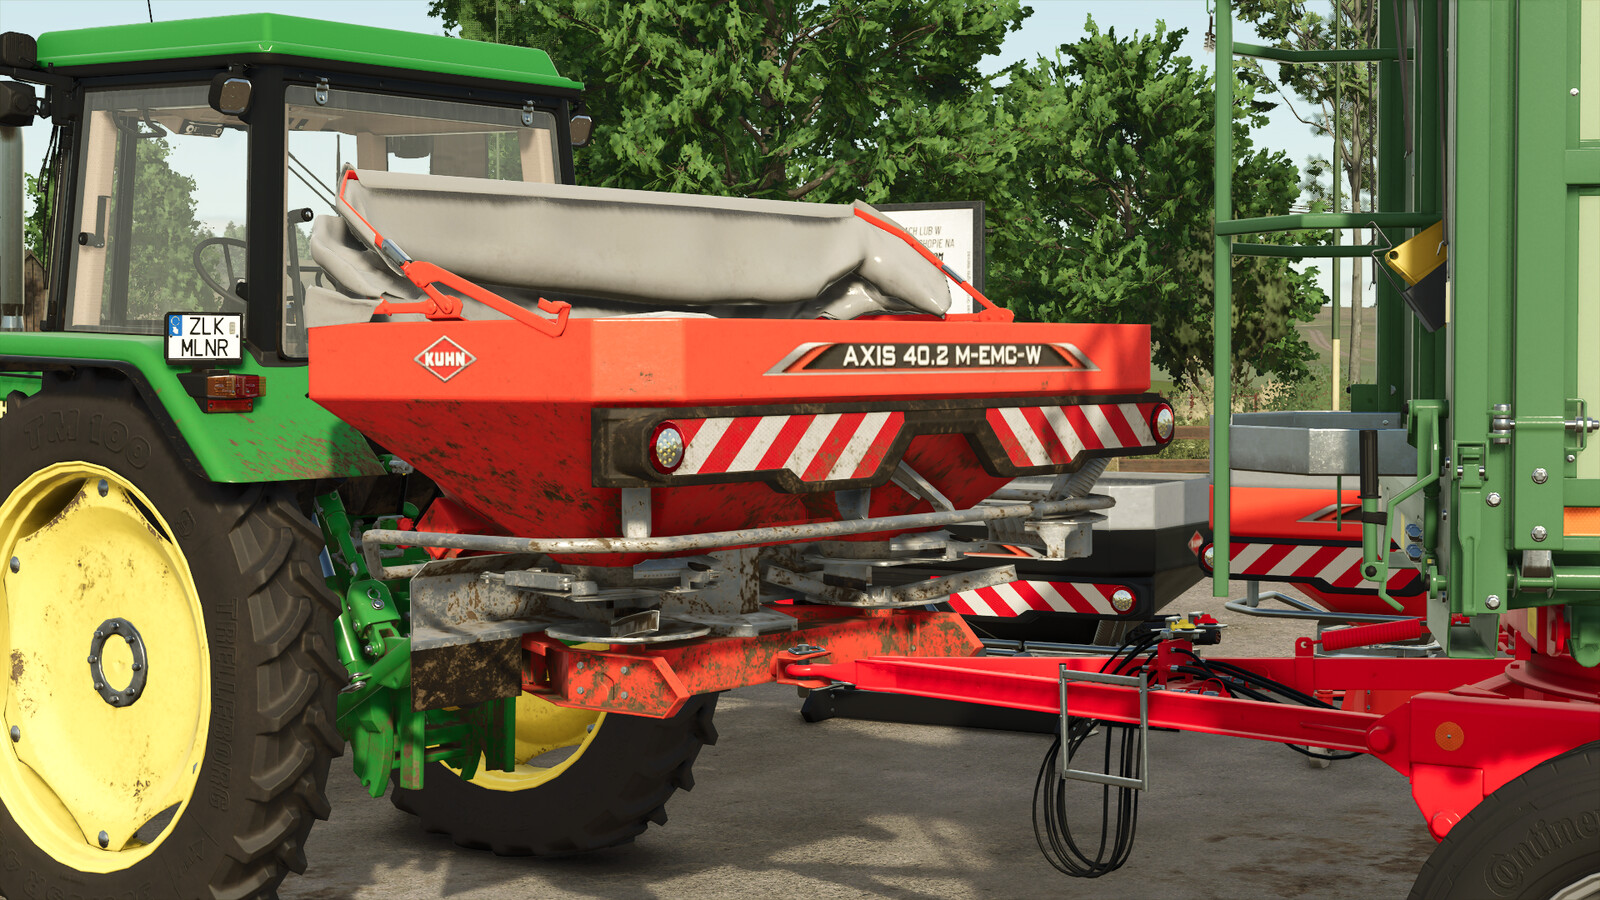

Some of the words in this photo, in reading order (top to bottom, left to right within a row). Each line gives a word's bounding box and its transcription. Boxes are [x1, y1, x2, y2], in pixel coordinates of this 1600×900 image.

[919, 226, 933, 236] LUB
[934, 225, 942, 235] W
[944, 238, 955, 248] NA
[189, 317, 224, 335] ZLK
[181, 339, 229, 357] MLNR
[843, 345, 896, 366] AXIS
[903, 345, 949, 366] 40.2
[955, 345, 1042, 365] M-EMC-W
[425, 351, 466, 367] KUHN
